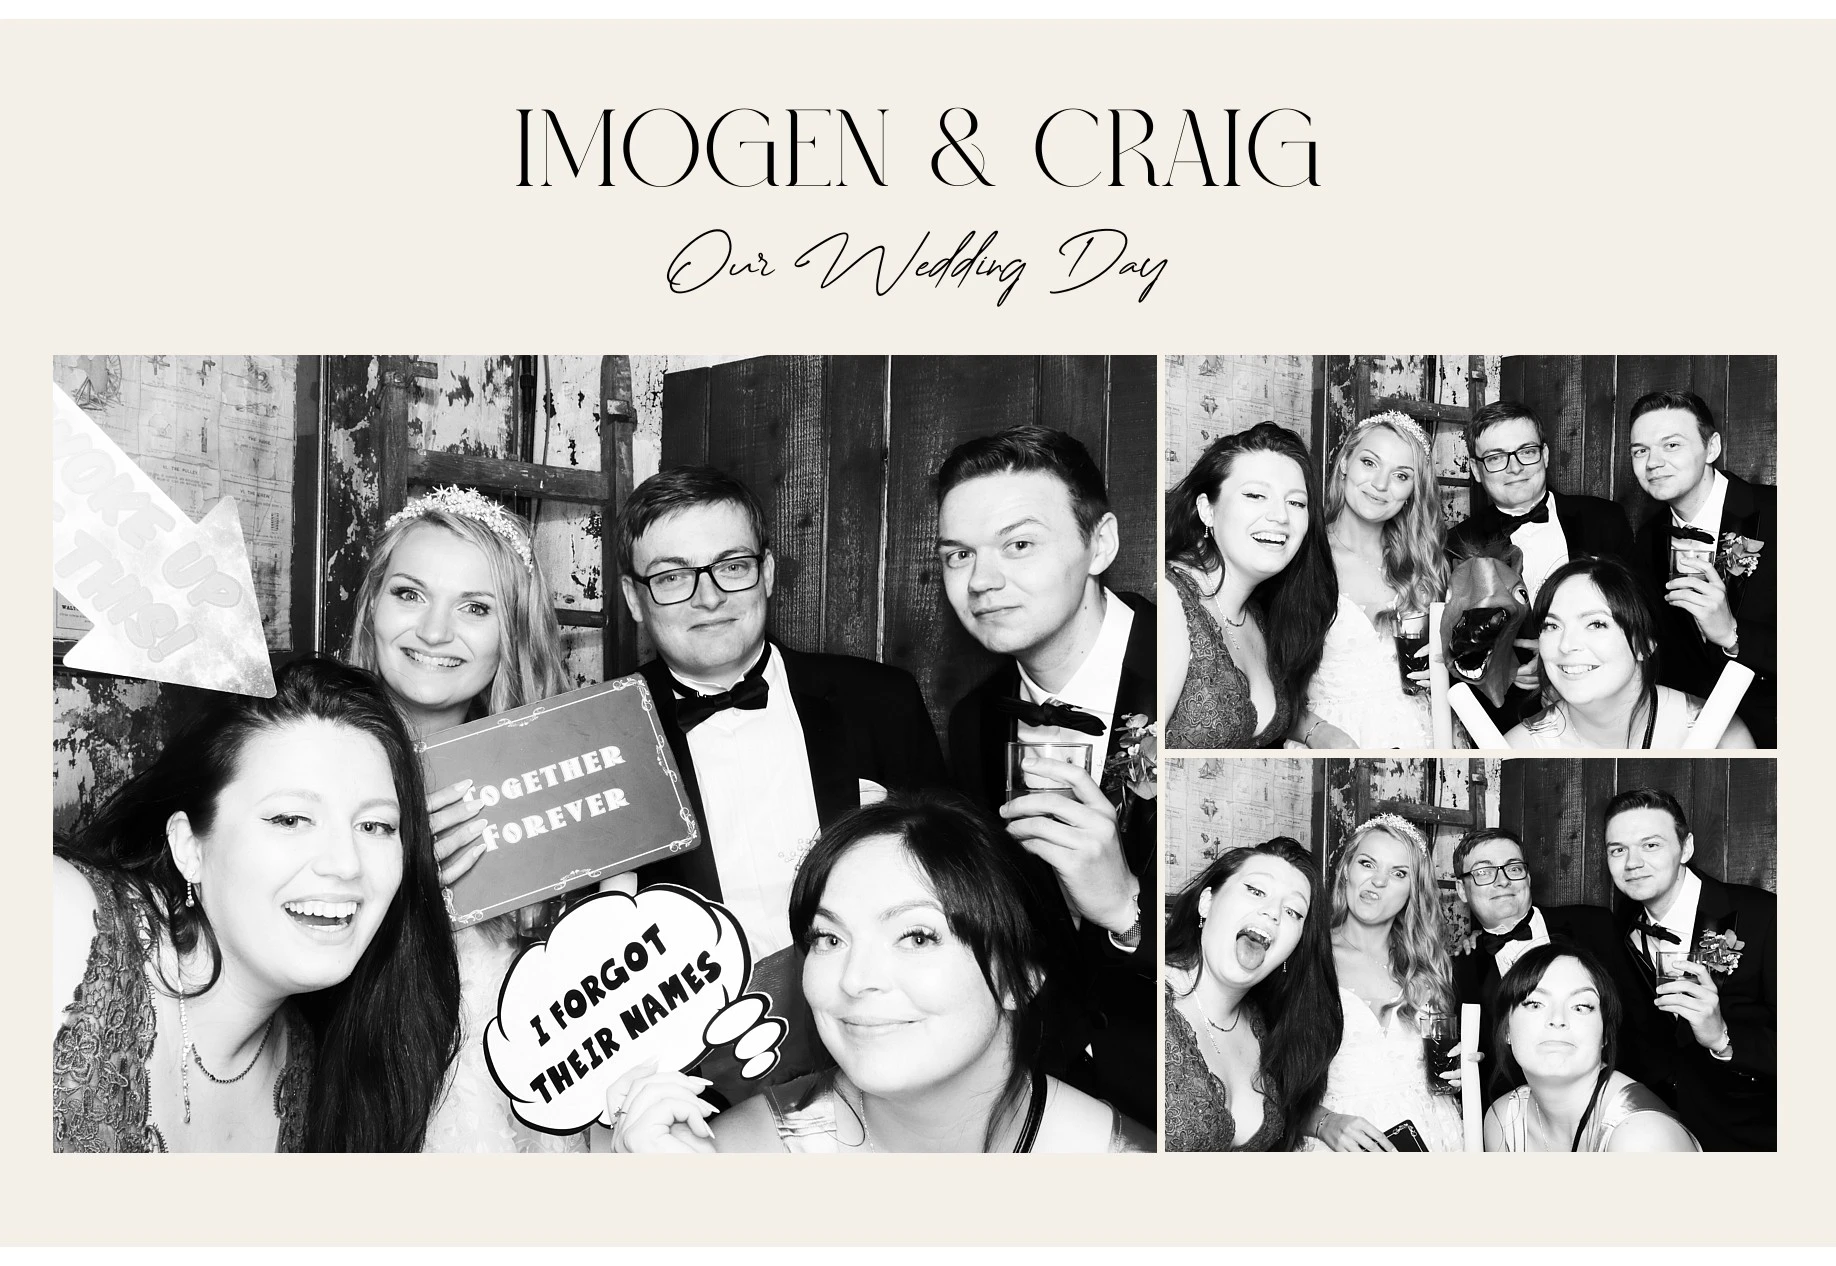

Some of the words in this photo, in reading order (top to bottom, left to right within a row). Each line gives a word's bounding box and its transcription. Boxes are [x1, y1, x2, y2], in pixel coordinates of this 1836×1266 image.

[54, 528, 198, 663] THIS!
[161, 540, 243, 609] UP
[481, 787, 631, 853] FOREVER
[529, 1014, 551, 1047] I
[549, 922, 667, 1030] FORGOT
[529, 1027, 621, 1104] THEIR
[619, 950, 722, 1041] NAMES
